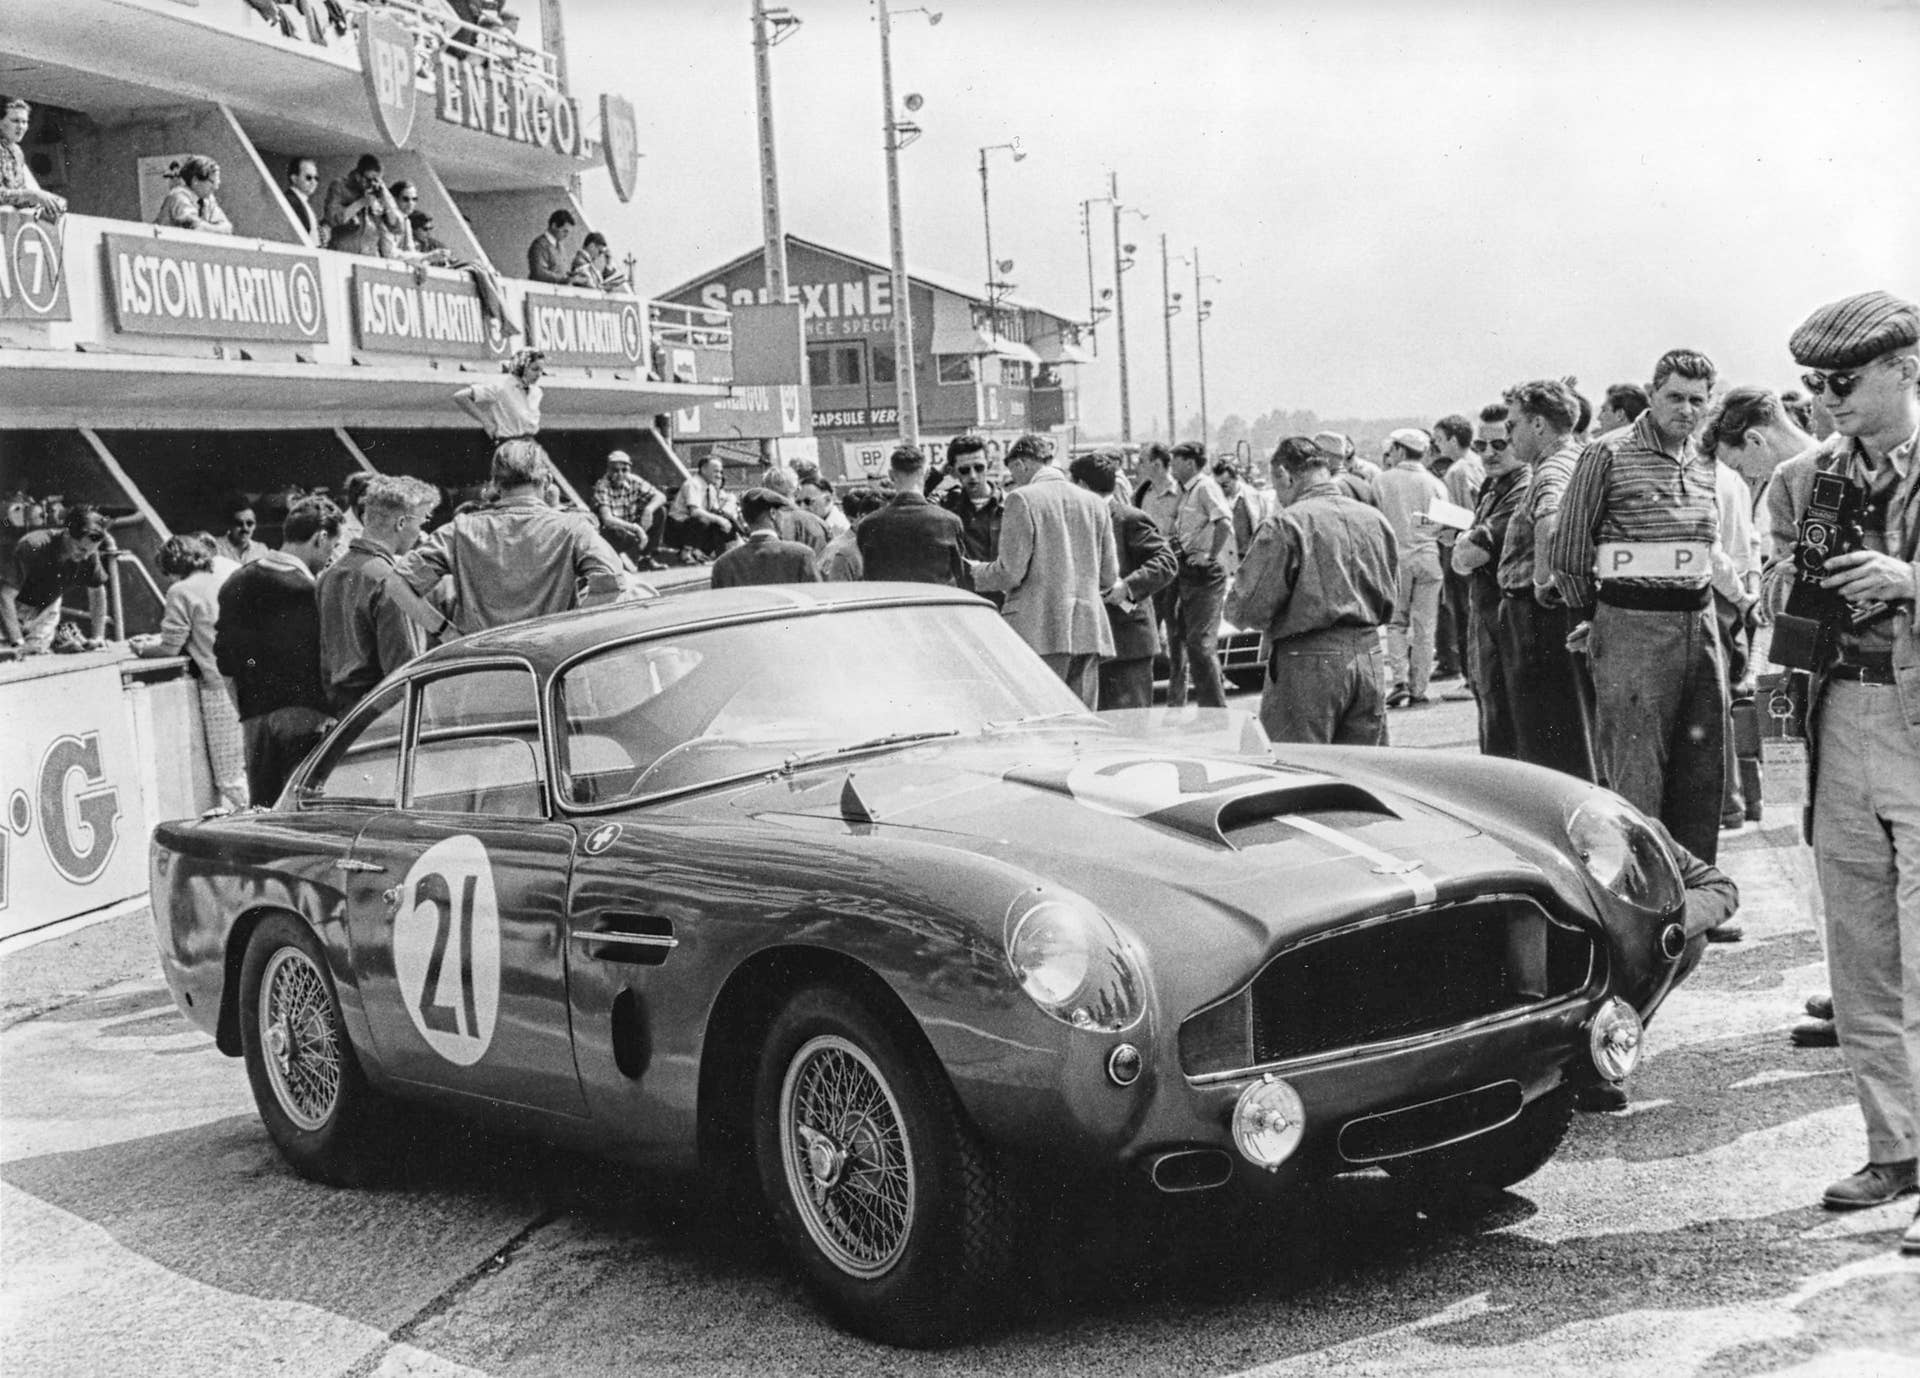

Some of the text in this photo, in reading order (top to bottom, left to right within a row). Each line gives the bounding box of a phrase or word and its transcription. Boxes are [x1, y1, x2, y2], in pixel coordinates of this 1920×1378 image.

[373, 38, 410, 109] BP
[439, 52, 593, 160] ENERGOL
[24, 241, 43, 294] 7
[118, 253, 313, 324] ASTON MARTIN 6
[363, 281, 422, 338] ASTON
[421, 290, 485, 343] MARTIN
[533, 306, 575, 350] ASTON
[575, 310, 624, 353] MARTIN
[810, 408, 900, 427] CAPSULE VER
[862, 450, 882, 467] BP
[1613, 549, 1693, 571] P P
[413, 872, 481, 1039] 21
